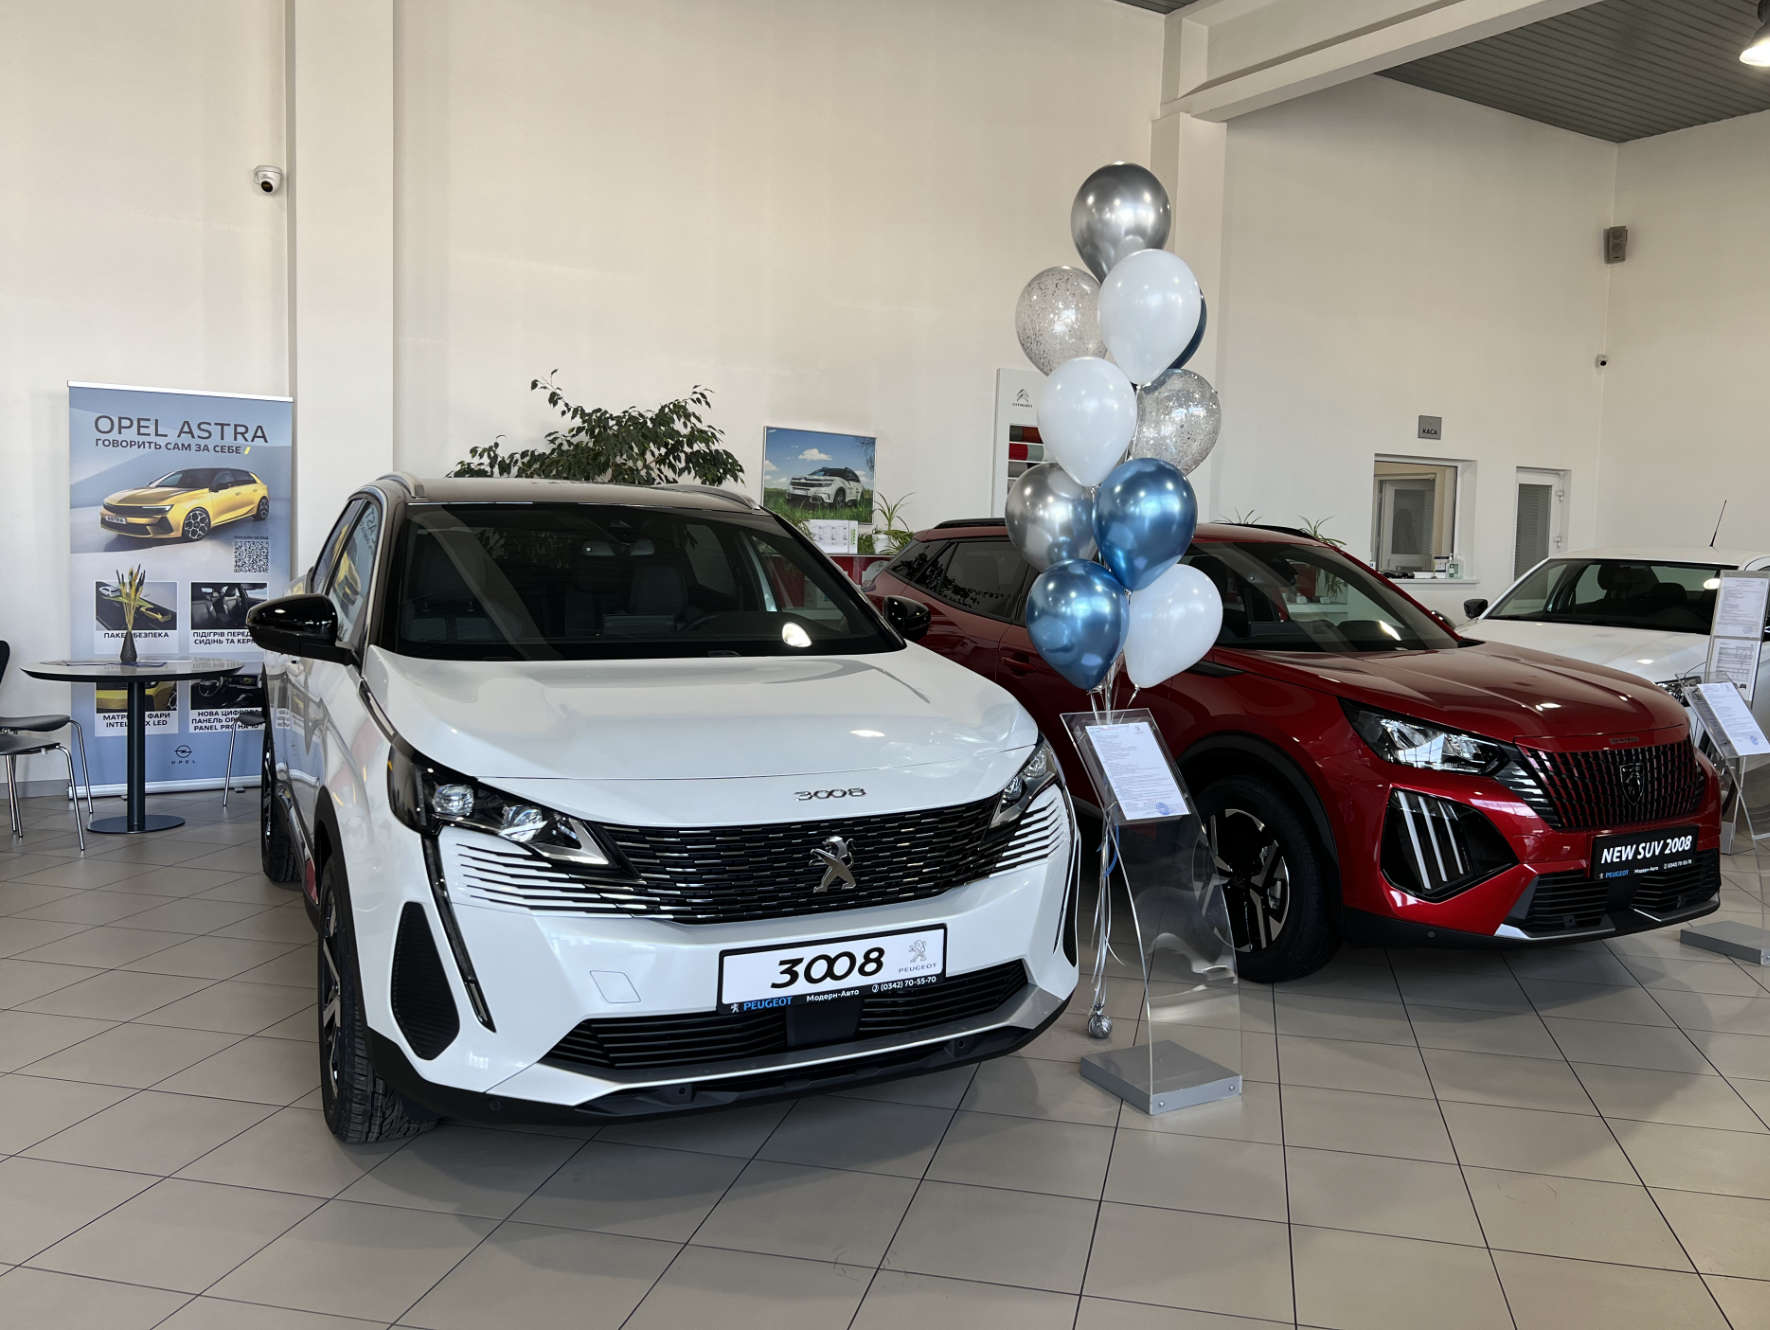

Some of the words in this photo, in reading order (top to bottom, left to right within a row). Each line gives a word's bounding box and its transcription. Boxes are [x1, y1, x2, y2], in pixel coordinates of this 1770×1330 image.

[94, 415, 168, 438] OPEL
[177, 420, 269, 443] ASTRA
[95, 438, 162, 450] ГОВОРИТЬ
[165, 442, 192, 452] САМ
[195, 443, 211, 454] ЗА
[213, 444, 241, 455] СЕБЕ
[193, 631, 225, 639] ПІДІГРІВ
[226, 631, 252, 639] ПЕРЕД
[194, 638, 223, 646] СИДІНЬ
[794, 788, 867, 801] 3008
[1601, 844, 1636, 864] NEW
[1637, 840, 1664, 859] SUV
[1664, 835, 1693, 855] 2008
[770, 947, 886, 989] 3008
[898, 963, 937, 973] PEUGEOT
[880, 981, 904, 992] (0342)
[904, 975, 937, 987] 70-55-70
[806, 988, 860, 1003] Модерн-Авто
[743, 996, 793, 1012] PEUGEOT
